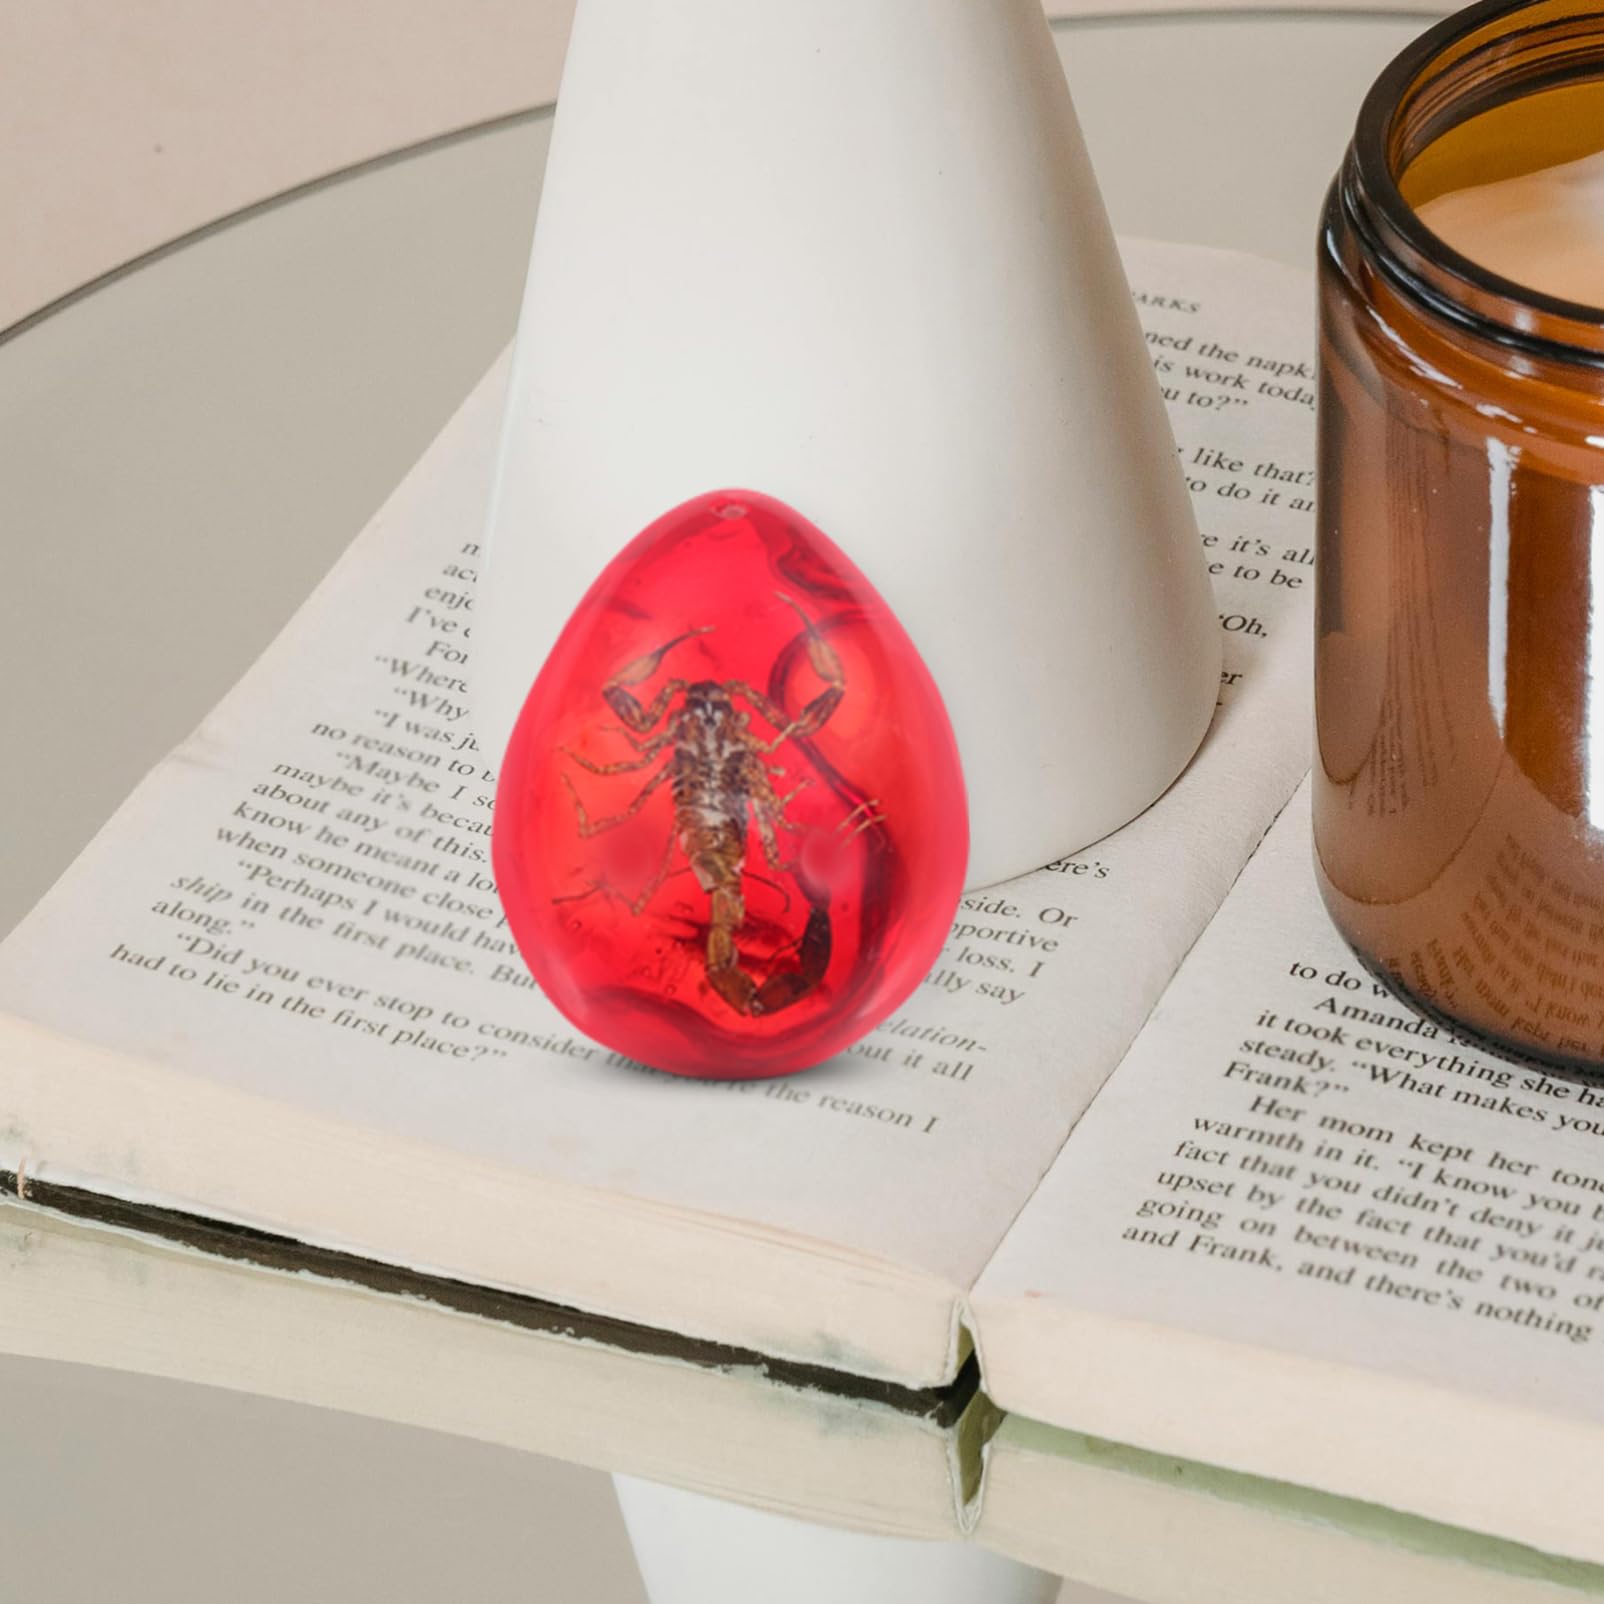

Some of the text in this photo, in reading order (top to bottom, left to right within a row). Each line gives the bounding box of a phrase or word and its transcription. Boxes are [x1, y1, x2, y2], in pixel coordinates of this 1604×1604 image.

[1198, 343, 1238, 362] the
[1247, 355, 1315, 379] napk
[1185, 365, 1250, 390] work
[1257, 381, 1315, 410] toda
[1193, 448, 1243, 472] like
[1217, 482, 1250, 499] do
[1262, 488, 1280, 505] it
[1230, 536, 1270, 556] it’s
[1233, 565, 1260, 580] to
[1271, 569, 1302, 589] be
[405, 606, 458, 633] I’ve
[394, 687, 469, 722] “Why
[310, 721, 474, 776] no reason to
[405, 720, 454, 743] was
[272, 763, 365, 797] maybe
[371, 786, 411, 812] it’s
[337, 752, 440, 795] “Maybe
[232, 800, 311, 836] know
[318, 825, 350, 848] he
[354, 842, 440, 877] meant
[444, 868, 461, 884] a
[251, 782, 489, 863] about any of this.
[216, 827, 287, 861] when
[295, 851, 416, 899] someone
[422, 891, 494, 921] close
[151, 899, 256, 937] along.”
[238, 859, 355, 912] “Perhaps
[385, 908, 470, 944] would
[1038, 907, 1079, 927] Or
[170, 874, 232, 905] ship
[241, 894, 270, 915] in
[278, 906, 324, 930] the
[332, 920, 389, 950] first
[392, 942, 475, 975] place.
[1029, 961, 1045, 978] I
[1288, 961, 1319, 981] to
[1324, 969, 1362, 991] do
[109, 943, 507, 1063] had to lie in the first place?”
[975, 982, 1025, 1005] say
[176, 932, 244, 966] “Did
[245, 956, 299, 984] you
[306, 976, 370, 1001] ever
[373, 994, 433, 1024] stop
[440, 1011, 471, 1029] to
[478, 1022, 600, 1063] consider
[818, 1093, 914, 1129] reason
[1313, 996, 1439, 1041] Amanda
[903, 1049, 923, 1068] it
[932, 1061, 974, 1080] all
[1256, 1009, 1279, 1029] it
[1283, 1017, 1350, 1048] took
[1356, 1036, 1514, 1088] everything
[1519, 1074, 1572, 1101] she
[1223, 1061, 1350, 1099] Frank?”
[1239, 1037, 1337, 1074] steady.
[1351, 1060, 1446, 1103] “What
[1451, 1087, 1548, 1124] makes
[1249, 1095, 1308, 1123] Her
[1317, 1114, 1396, 1146] mom
[1408, 1133, 1475, 1167] kept
[1487, 1150, 1539, 1177] her
[1193, 1117, 1305, 1154] warmth
[1313, 1141, 1343, 1163] in
[1353, 1151, 1380, 1172] it.
[1431, 1168, 1518, 1202] know
[1525, 1190, 1581, 1219] you
[1173, 1141, 1230, 1168] fact
[1239, 1154, 1298, 1182] that
[1305, 1169, 1363, 1199] you
[1372, 1184, 1461, 1221] didn’t
[1469, 1206, 1549, 1241] deny
[1552, 1223, 1580, 1245] it
[1156, 1168, 1238, 1201] upset
[1246, 1186, 1287, 1210] by
[1295, 1197, 1344, 1223] the
[1354, 1209, 1413, 1238] fact
[1421, 1224, 1485, 1254] that
[1488, 1243, 1577, 1276] you’d
[1135, 1198, 1226, 1233] going
[1239, 1215, 1277, 1238] on
[1292, 1223, 1420, 1269] between
[1435, 1255, 1485, 1284] the
[1500, 1272, 1559, 1302] two
[1120, 1223, 1594, 1345] and Frank, and there’s nothing
